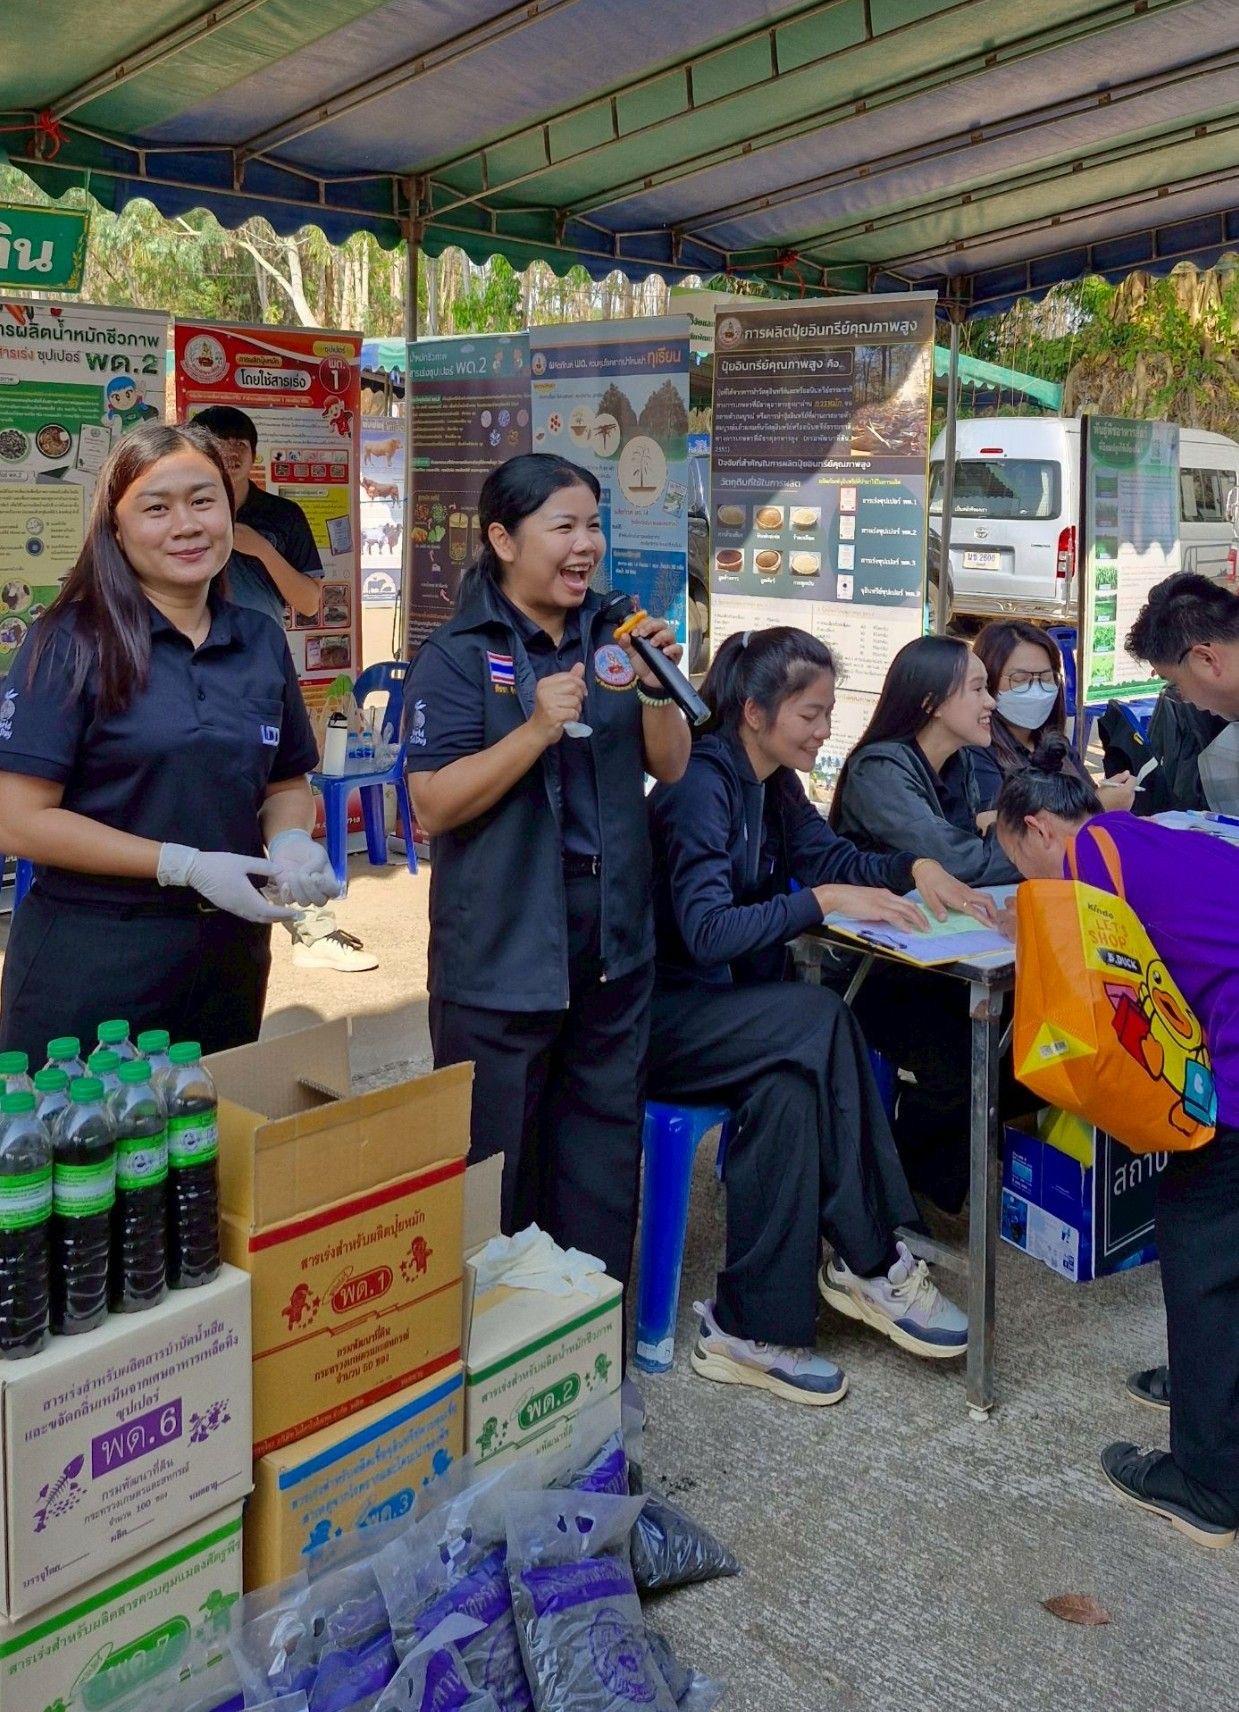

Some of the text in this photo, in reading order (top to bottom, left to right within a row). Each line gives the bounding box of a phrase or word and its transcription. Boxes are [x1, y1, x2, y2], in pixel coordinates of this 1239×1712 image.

[0, 221, 54, 272] ิน
[744, 320, 918, 342] การผลิตปุ๋ยอินทรีย์คุณภาพสูง
[85, 352, 159, 376] พด.2
[721, 358, 824, 375] ปุ๋ยอินทรีย์คุณภาพสูง
[241, 368, 307, 389] โดยใช้สารเร่ง
[527, 1380, 575, 1421] พด.2
[102, 1406, 177, 1466] พด.6
